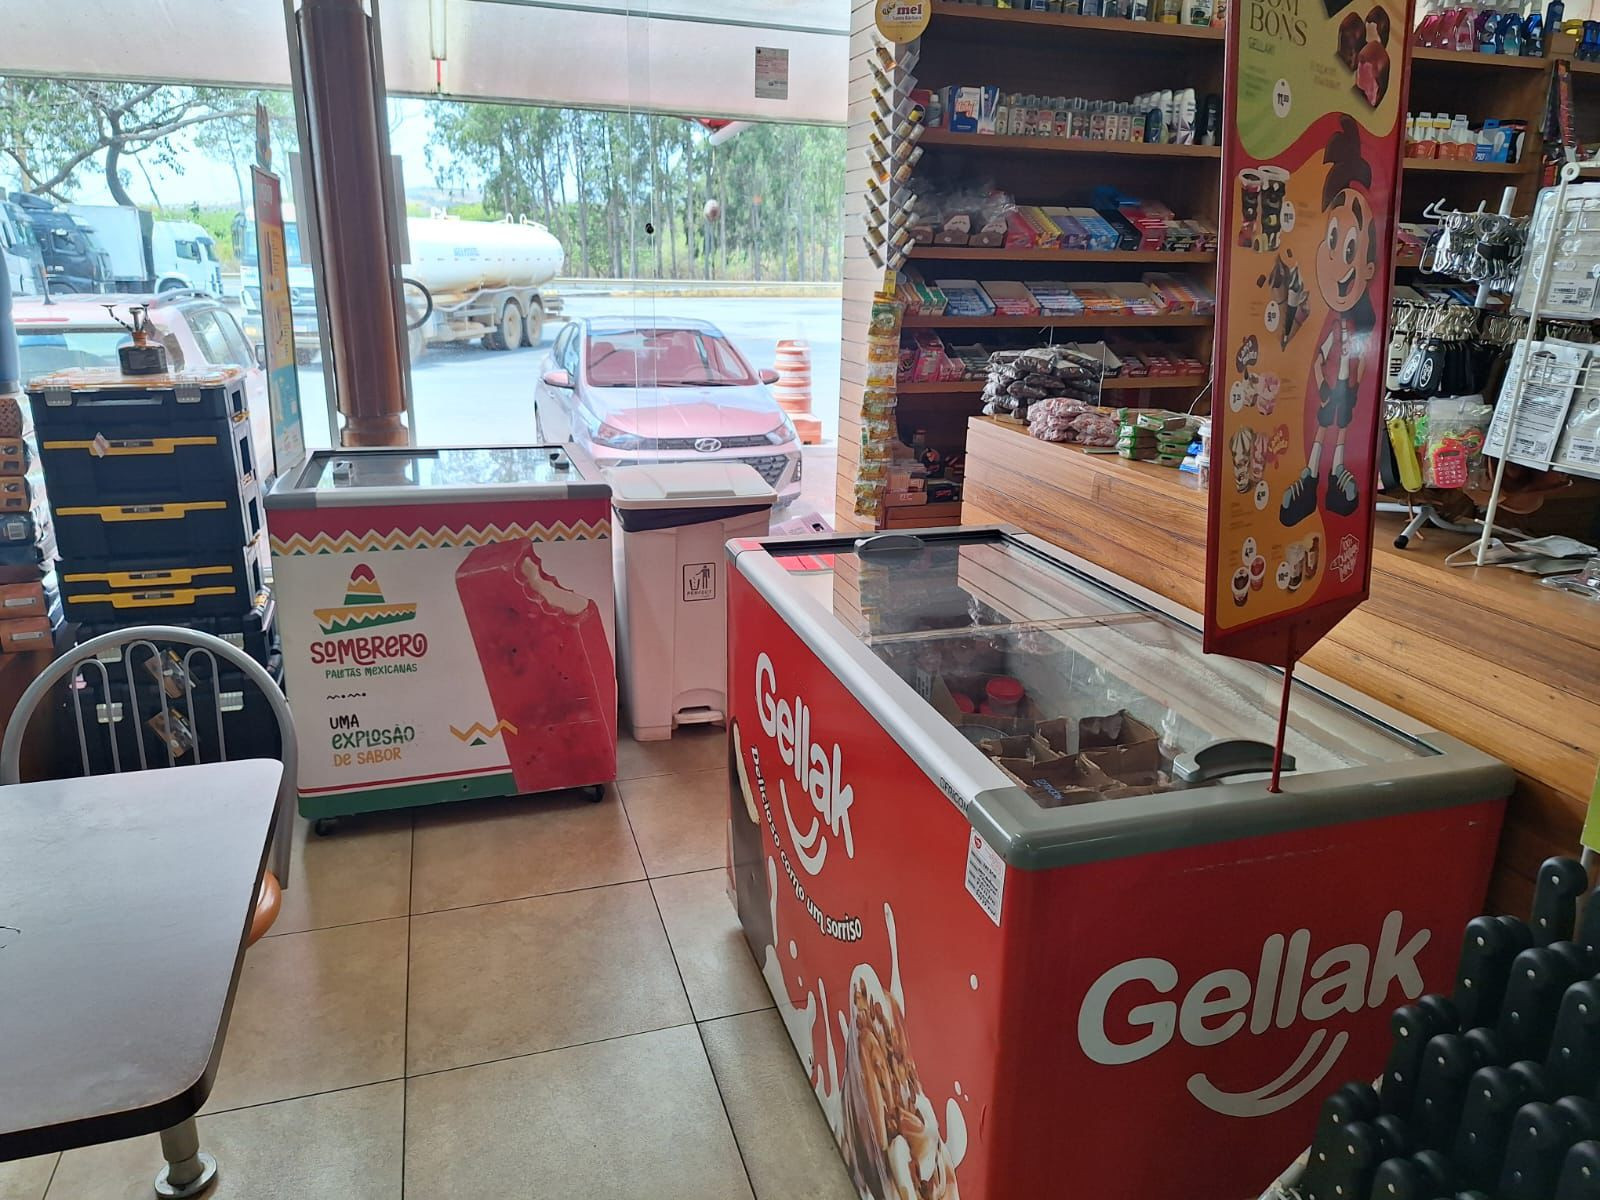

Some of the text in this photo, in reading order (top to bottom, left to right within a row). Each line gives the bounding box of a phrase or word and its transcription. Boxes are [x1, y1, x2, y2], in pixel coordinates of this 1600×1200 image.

[897, 4, 922, 15] mel
[1250, 2, 1307, 47] BONS
[1389, 358, 1402, 376] FIAT
[329, 713, 360, 730] UMA
[357, 746, 402, 764] SABOR
[755, 652, 854, 859] Gellak
[751, 744, 863, 943] Delicioso como um sorriso
[1077, 910, 1431, 1065] Gellak
